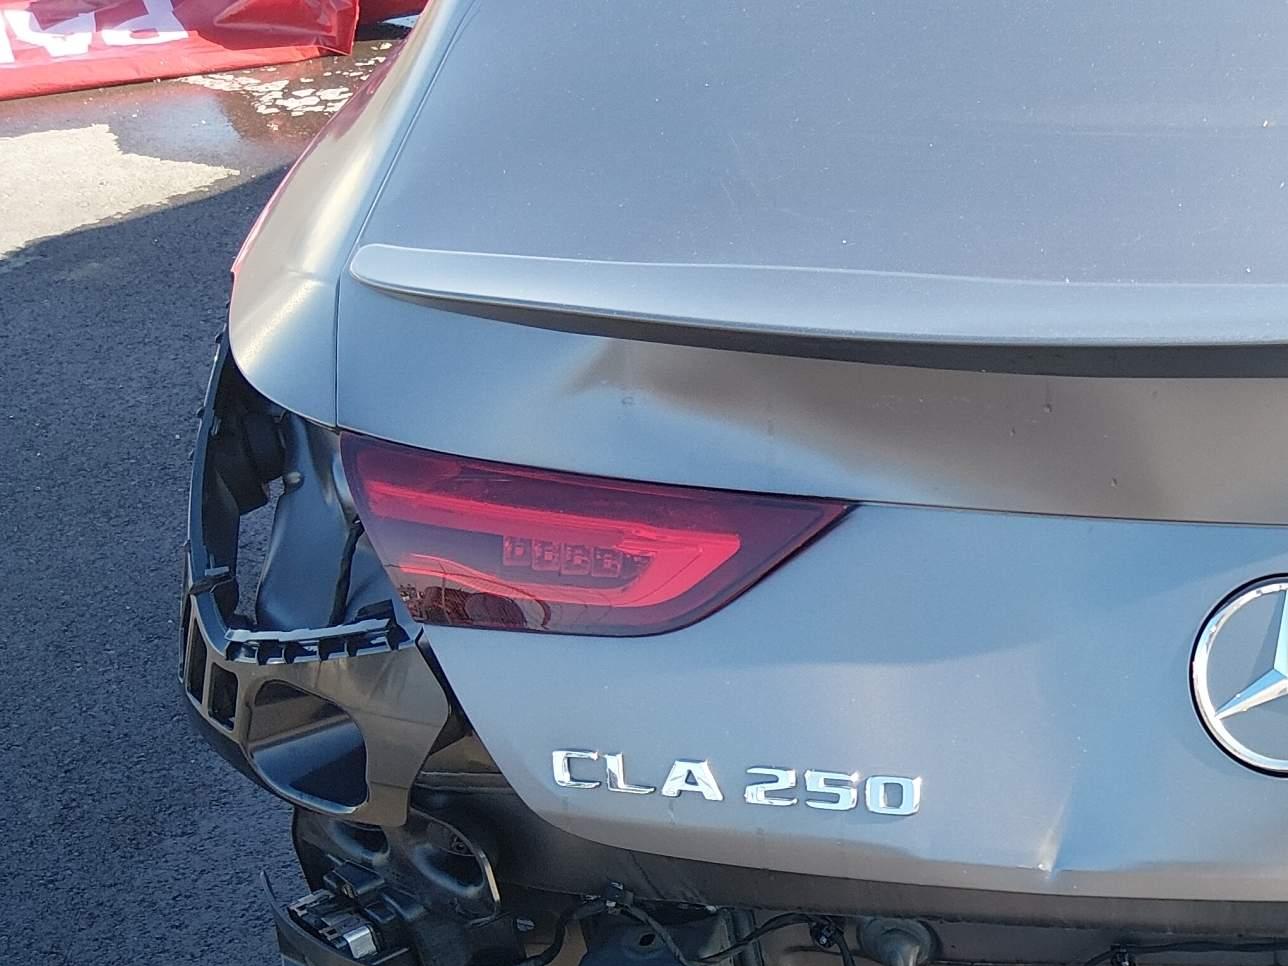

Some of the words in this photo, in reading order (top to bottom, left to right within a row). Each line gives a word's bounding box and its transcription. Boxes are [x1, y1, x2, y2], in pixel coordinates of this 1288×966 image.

[0, 0, 190, 65] PA
[551, 748, 725, 802] CLA
[743, 765, 923, 817] 250
